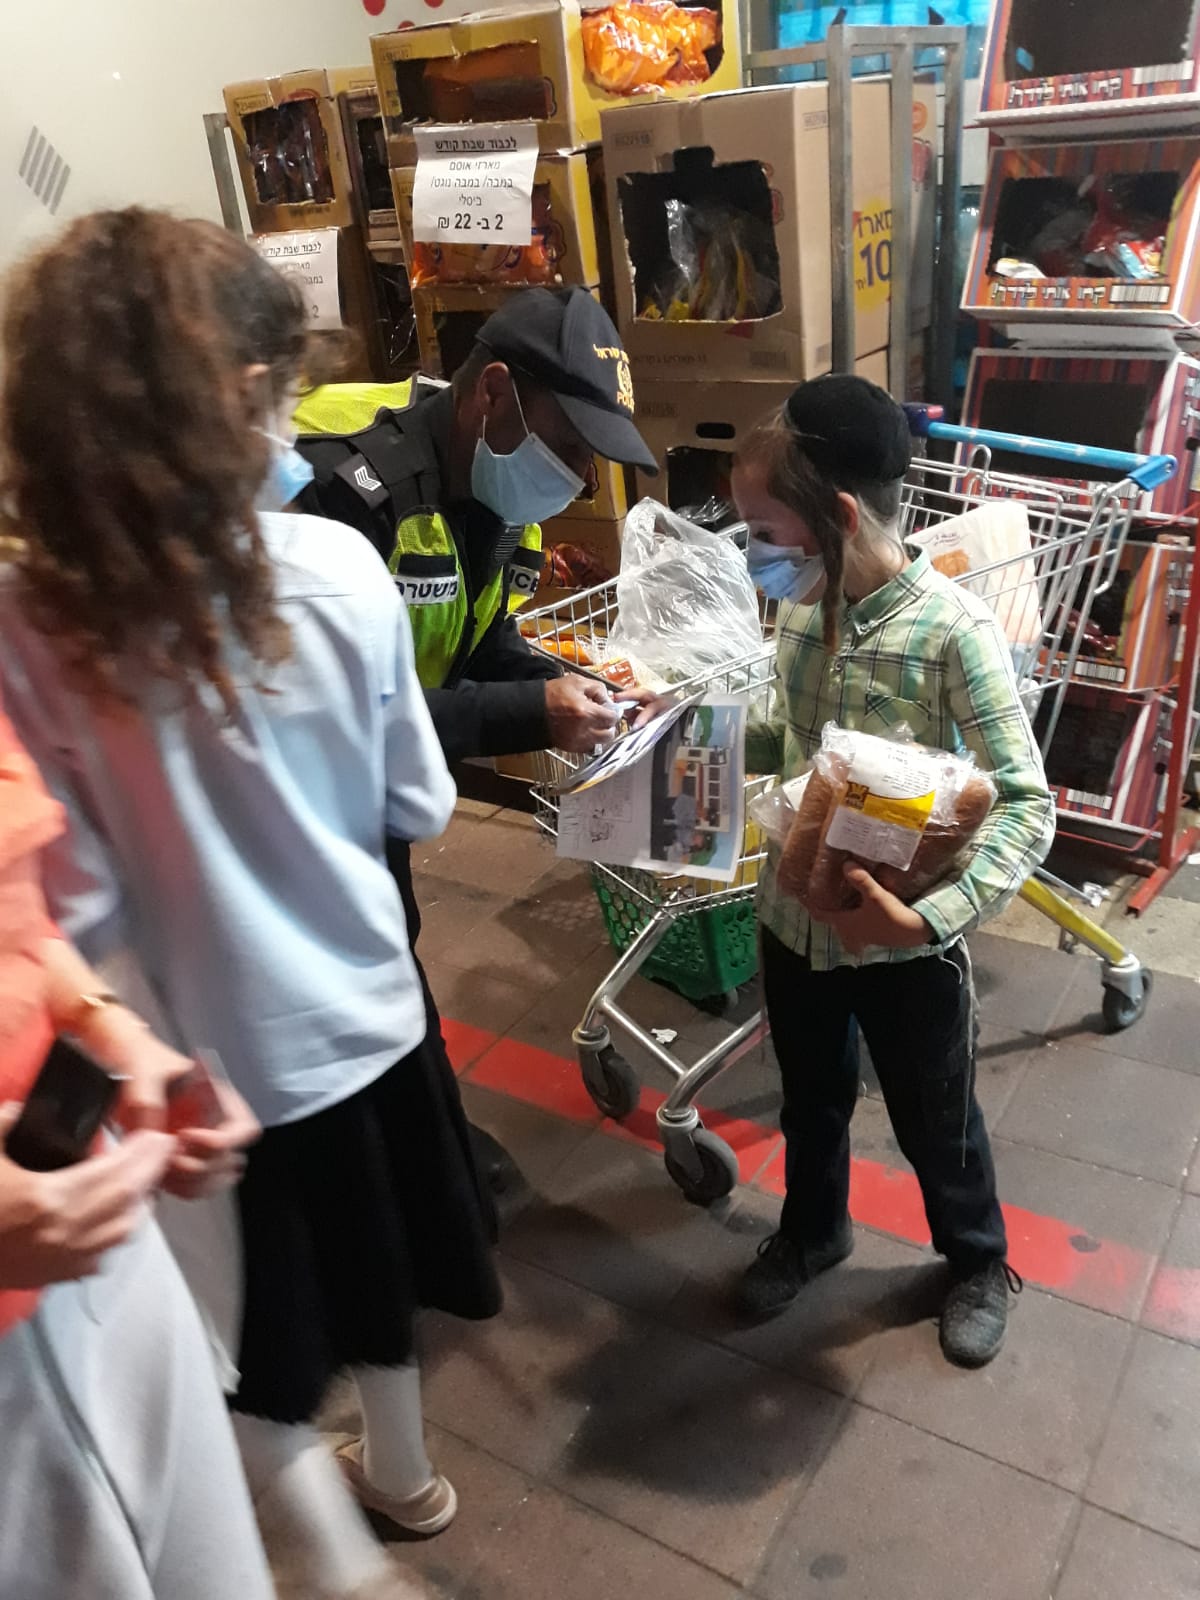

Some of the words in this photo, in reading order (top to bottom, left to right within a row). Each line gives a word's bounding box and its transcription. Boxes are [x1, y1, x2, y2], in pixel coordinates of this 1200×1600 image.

[434, 140, 459, 152] קודש
[461, 140, 485, 150] שבת
[488, 136, 517, 150] לכבוד
[449, 161, 471, 171] אוסם
[475, 161, 500, 170] מארזי
[454, 179, 480, 188] במבה
[458, 194, 482, 207] ביסלי
[437, 216, 450, 229] ₪
[454, 213, 472, 230] 22
[476, 218, 490, 230] ב-
[495, 214, 504, 230] 2
[283, 245, 299, 254] שבת
[859, 239, 892, 288] 10
[311, 304, 320, 319] 2
